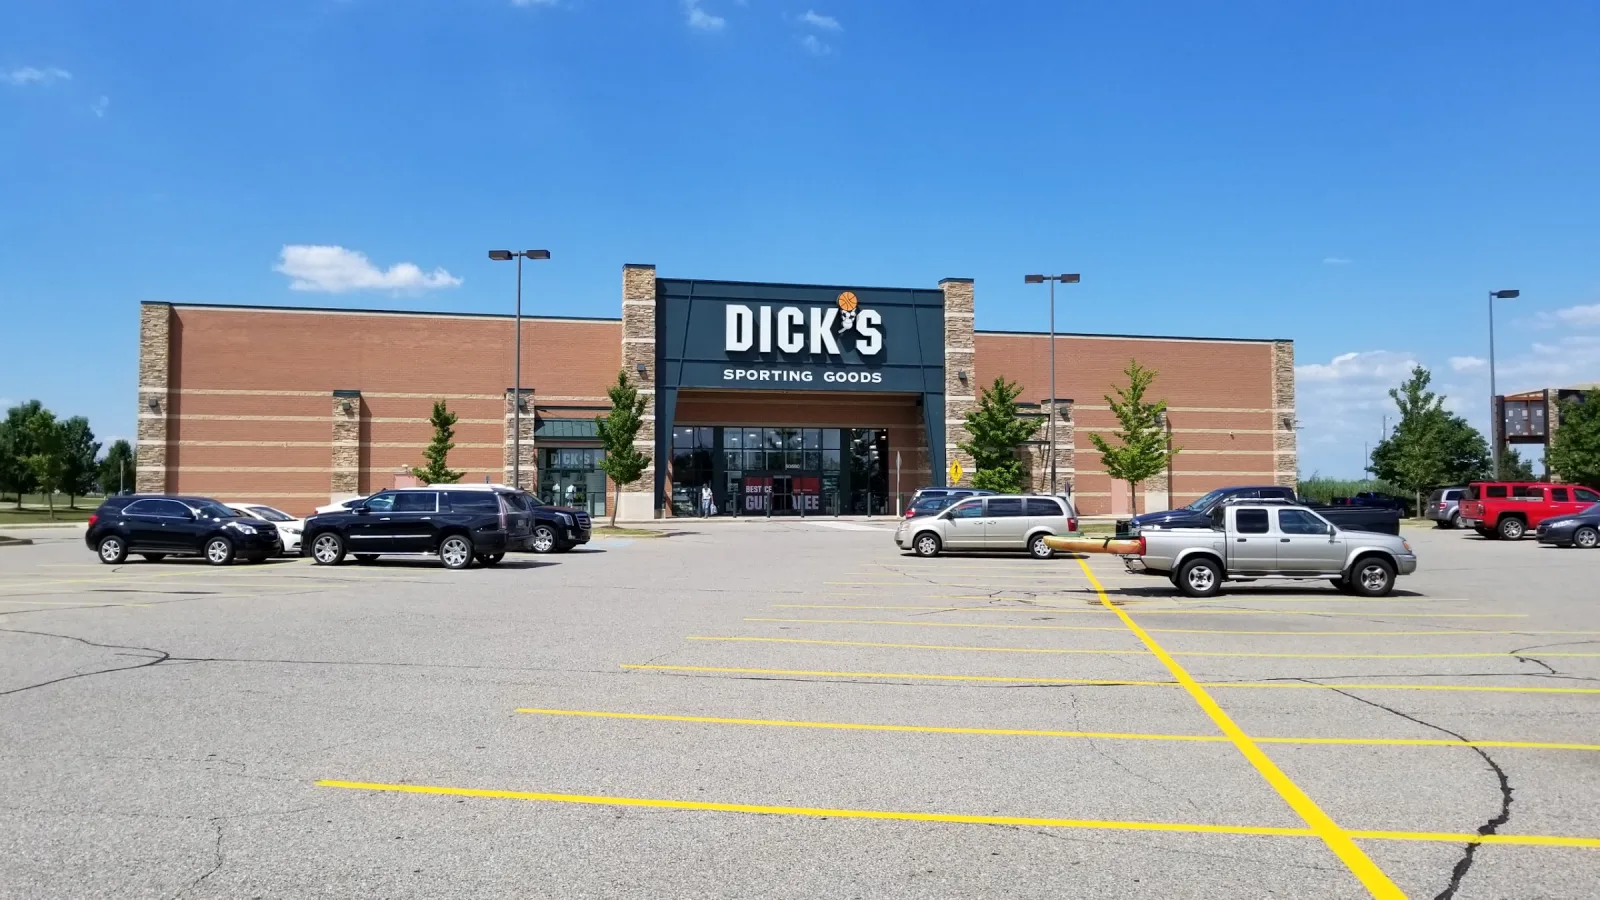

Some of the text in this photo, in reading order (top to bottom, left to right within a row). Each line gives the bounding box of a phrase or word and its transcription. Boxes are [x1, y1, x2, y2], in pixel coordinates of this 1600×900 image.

[725, 303, 883, 356] DICK'S
[723, 369, 882, 383] SPORTING GOODS
[745, 485, 762, 493] BEST
